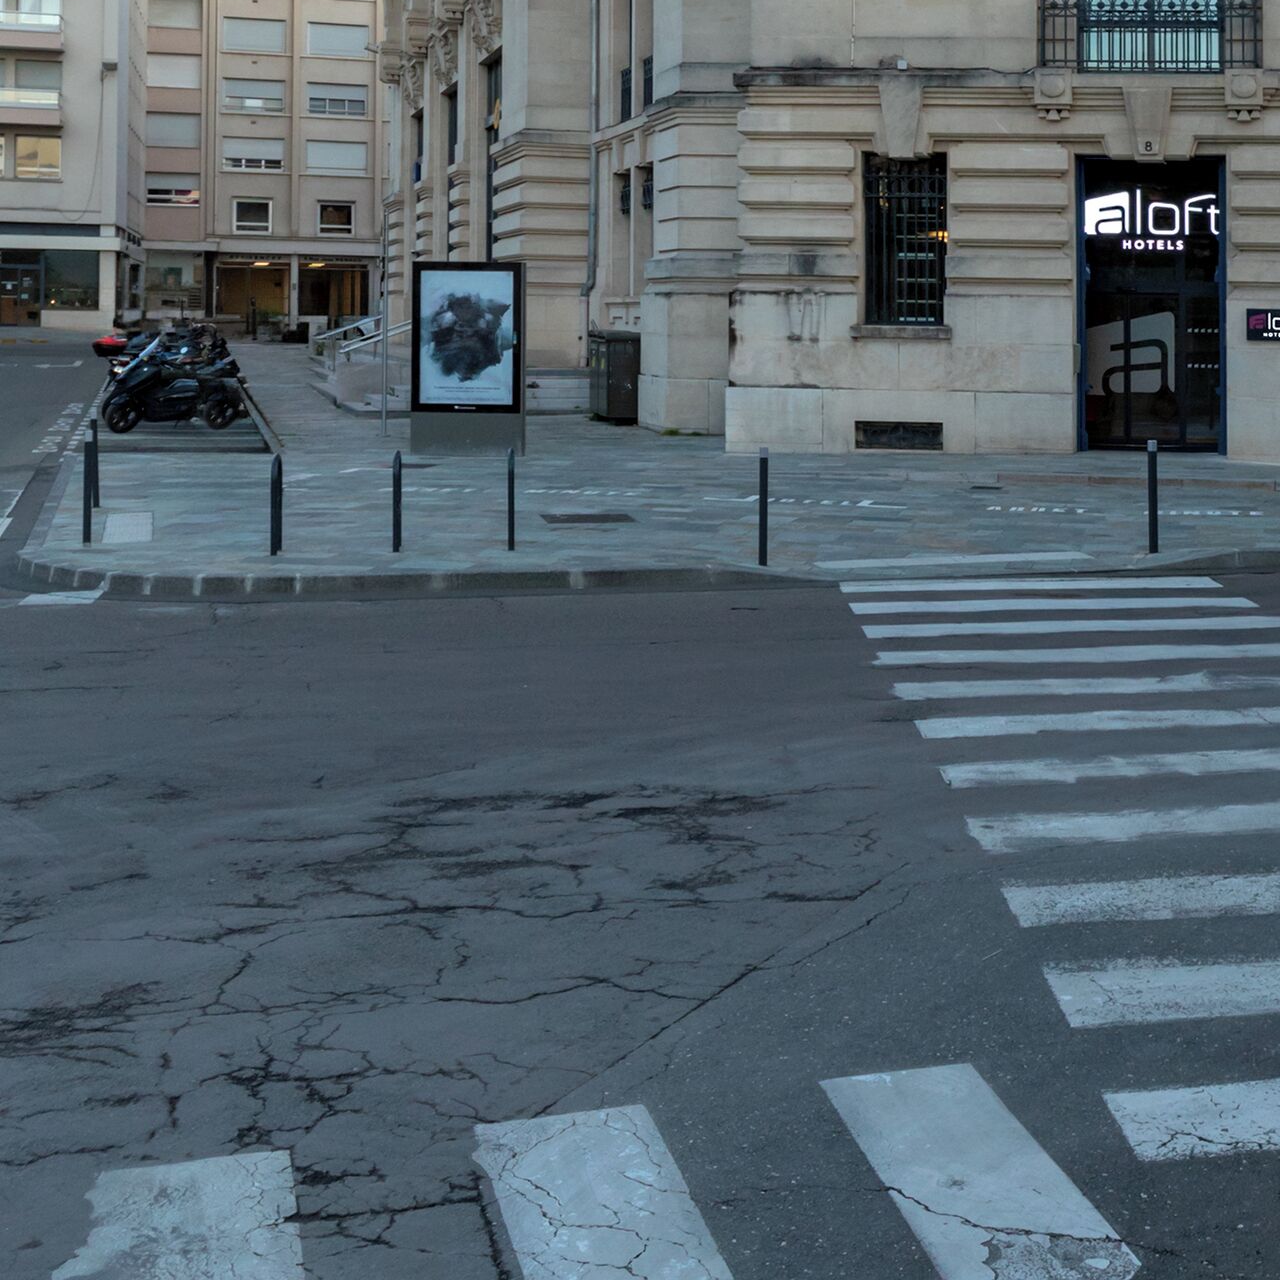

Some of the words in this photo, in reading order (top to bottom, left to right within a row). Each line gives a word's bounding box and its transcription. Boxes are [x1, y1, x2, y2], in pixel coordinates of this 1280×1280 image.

[1144, 141, 1153, 152] 8
[1084, 188, 1220, 235] aloft
[1122, 239, 1185, 251] HOTELS
